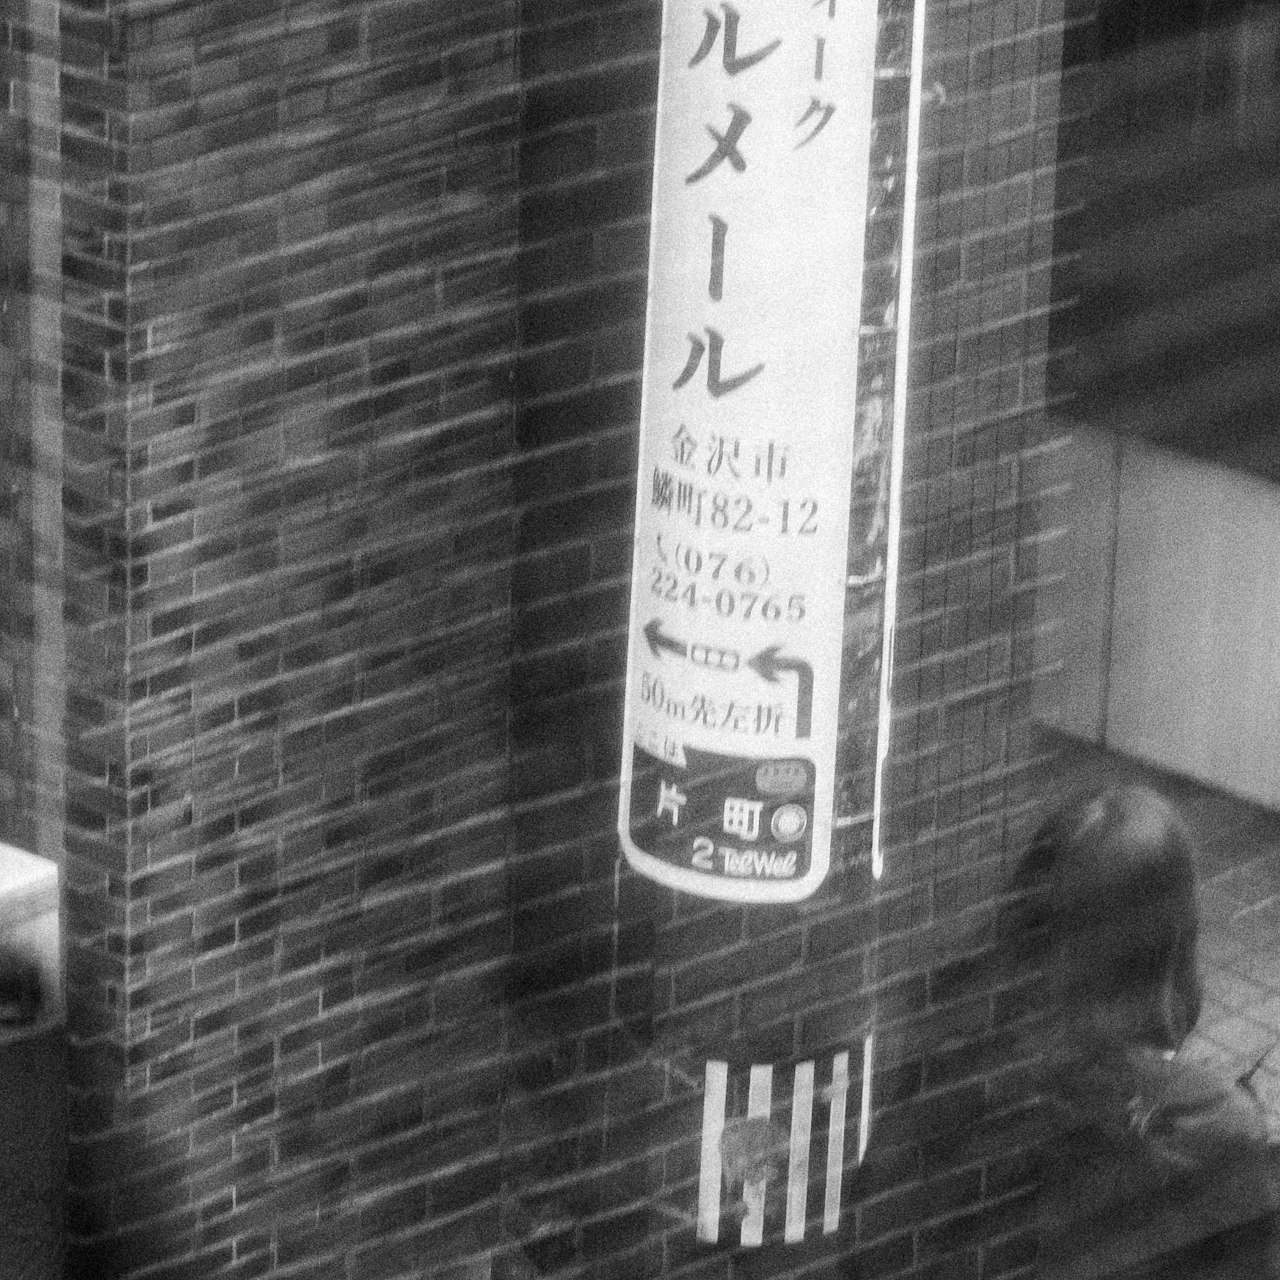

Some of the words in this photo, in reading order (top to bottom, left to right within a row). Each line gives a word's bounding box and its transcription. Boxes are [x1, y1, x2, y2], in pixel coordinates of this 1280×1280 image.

[672, 2, 783, 399] ルメール
[671, 423, 792, 483] 金沢市
[650, 567, 807, 622] 224-0765
